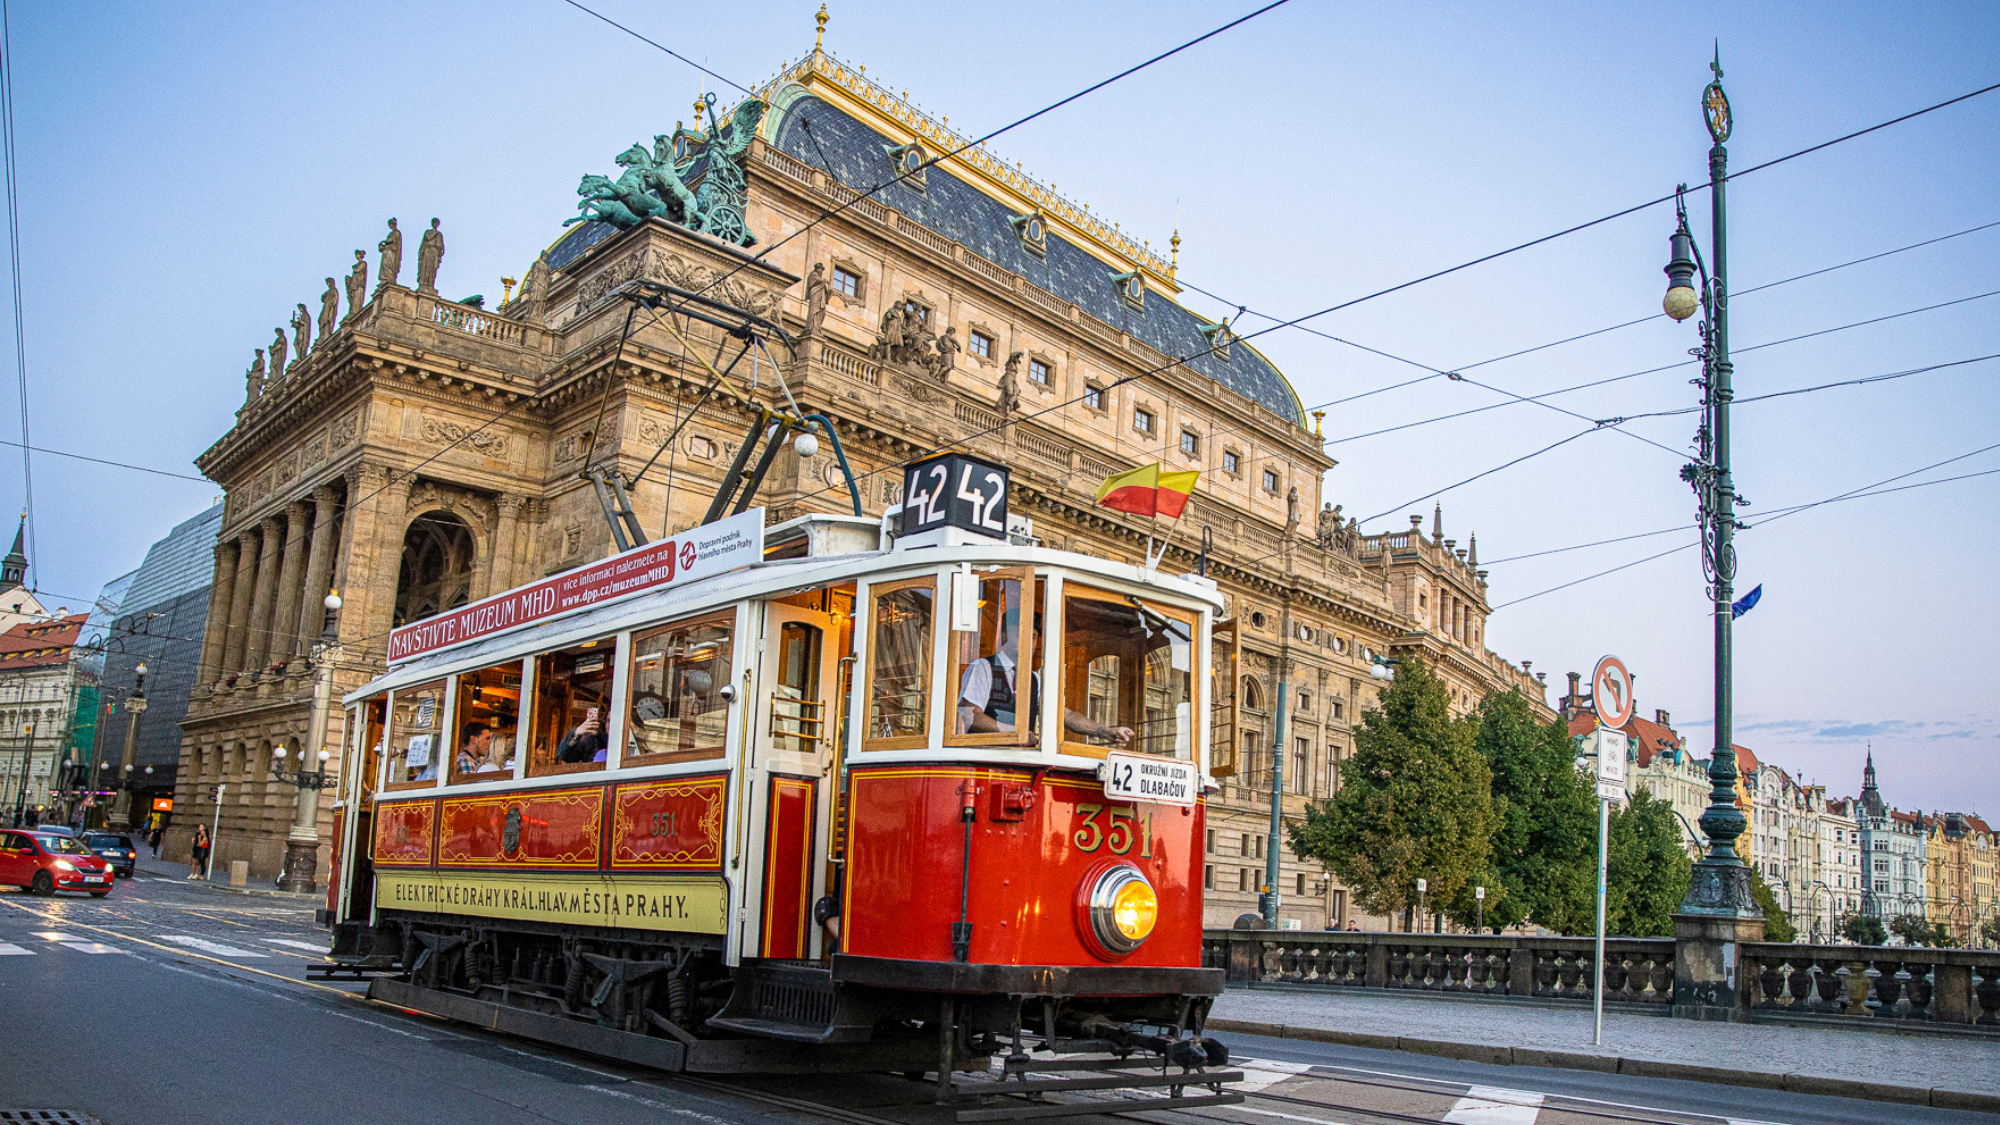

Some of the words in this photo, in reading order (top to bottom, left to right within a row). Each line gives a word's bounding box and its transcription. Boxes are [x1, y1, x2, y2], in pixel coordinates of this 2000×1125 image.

[906, 464, 948, 526] 42
[956, 463, 1005, 532] 42
[698, 547, 720, 561] hlavního
[720, 543, 736, 556] města
[737, 538, 753, 553] Prahy
[699, 536, 722, 550] Dopravní
[722, 530, 741, 545] podnik
[562, 565, 670, 607] www.dpp.cz/muzeumMHD
[563, 575, 578, 591] více
[579, 562, 615, 585] informací
[616, 552, 655, 574] naleznete
[657, 549, 669, 563] na
[391, 618, 456, 657] NAVŠTIVTE
[460, 596, 516, 639] MUZEUM
[520, 587, 555, 624] MHD
[1112, 763, 1133, 792] 42
[1140, 763, 1168, 777] OKRUŽNÍ
[1170, 766, 1187, 780] JÍZDA
[1140, 779, 1186, 798] DLABAČOV
[652, 812, 676, 838] 351
[1074, 803, 1152, 858] 351
[396, 883, 460, 905] ELEKTRICKÉ
[463, 885, 500, 908] DRÁHY
[626, 894, 689, 919] PRAHY.
